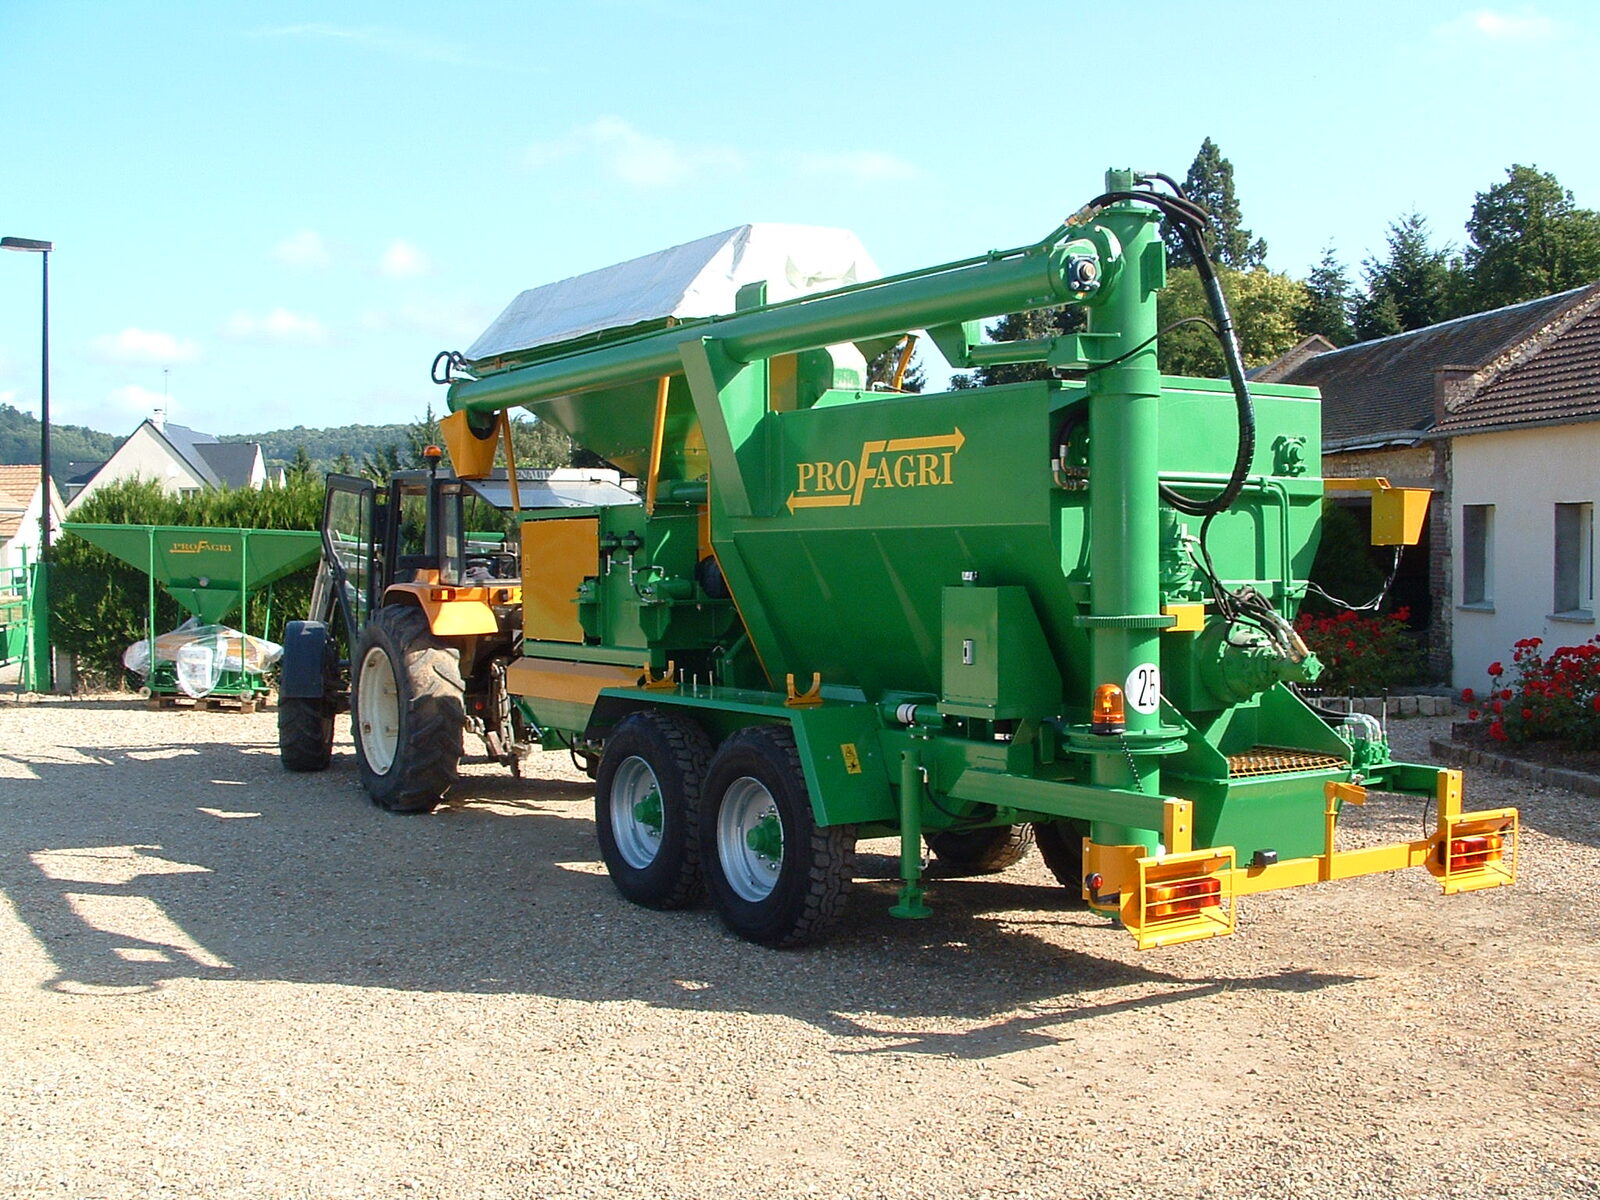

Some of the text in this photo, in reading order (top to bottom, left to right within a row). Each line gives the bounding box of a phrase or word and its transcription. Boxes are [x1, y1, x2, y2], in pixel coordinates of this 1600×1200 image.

[796, 440, 954, 506] PROFAGRI
[172, 540, 232, 553] PROFAGRI
[1138, 669, 1156, 707] 25
